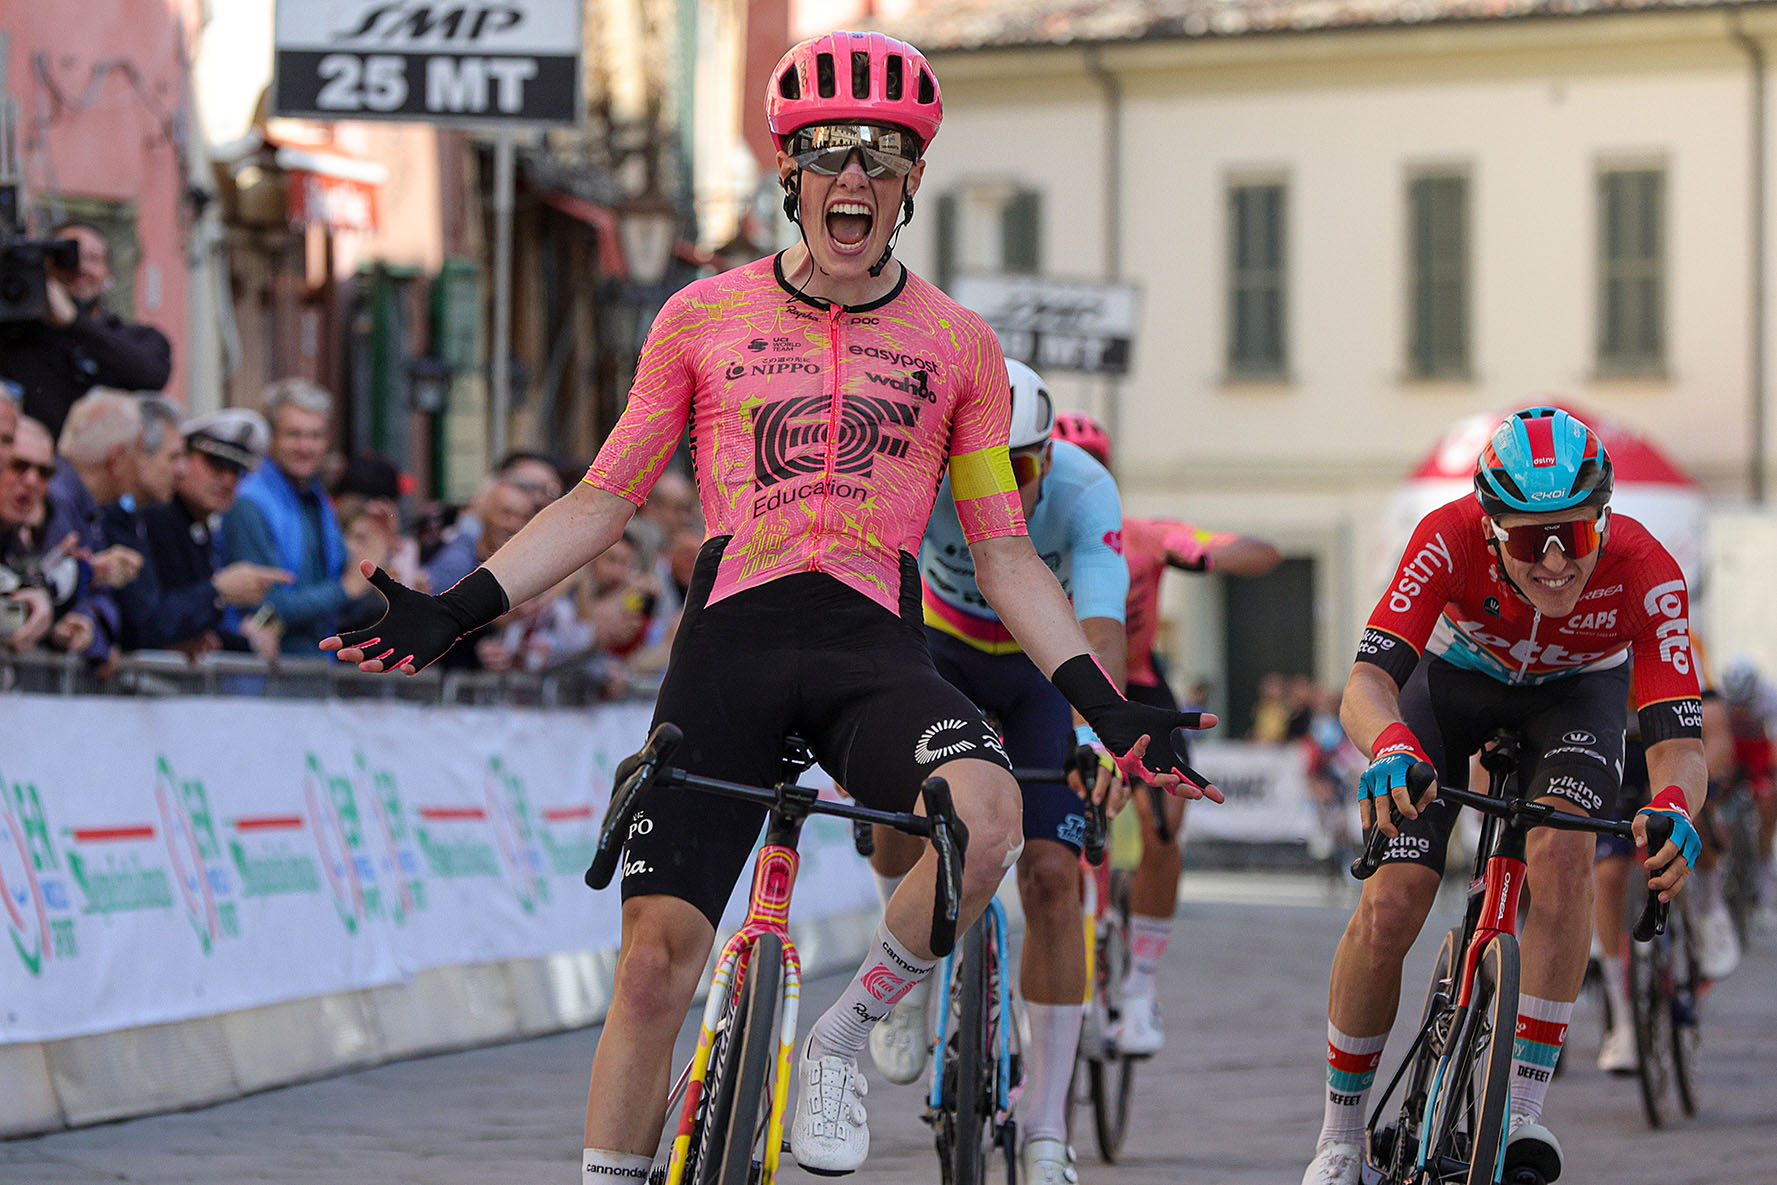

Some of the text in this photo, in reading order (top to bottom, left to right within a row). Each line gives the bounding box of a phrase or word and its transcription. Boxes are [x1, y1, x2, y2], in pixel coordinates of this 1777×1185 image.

[332, 6, 522, 40] SMP
[316, 54, 538, 113] 25 MT
[851, 317, 880, 325] poc
[752, 363, 820, 376] NIPPO
[849, 345, 939, 376] easypost
[865, 371, 937, 404] wahoo
[1533, 457, 1556, 465] dstny
[753, 480, 867, 519] Education
[1389, 532, 1453, 613] dstny
[1581, 584, 1623, 600] RBEA
[1568, 609, 1618, 629] CAPS
[1362, 629, 1396, 651] king
[1672, 701, 1702, 716] viki
[1678, 714, 1702, 727] lott
[1546, 785, 1592, 810] lotto
[1549, 776, 1603, 809] viking
[1525, 802, 1546, 810] GARMIN
[1389, 832, 1430, 853] king
[1498, 872, 1510, 919] ORBEA
[1517, 1065, 1550, 1083] DEFEET
[1330, 1091, 1362, 1106] DEFEET
